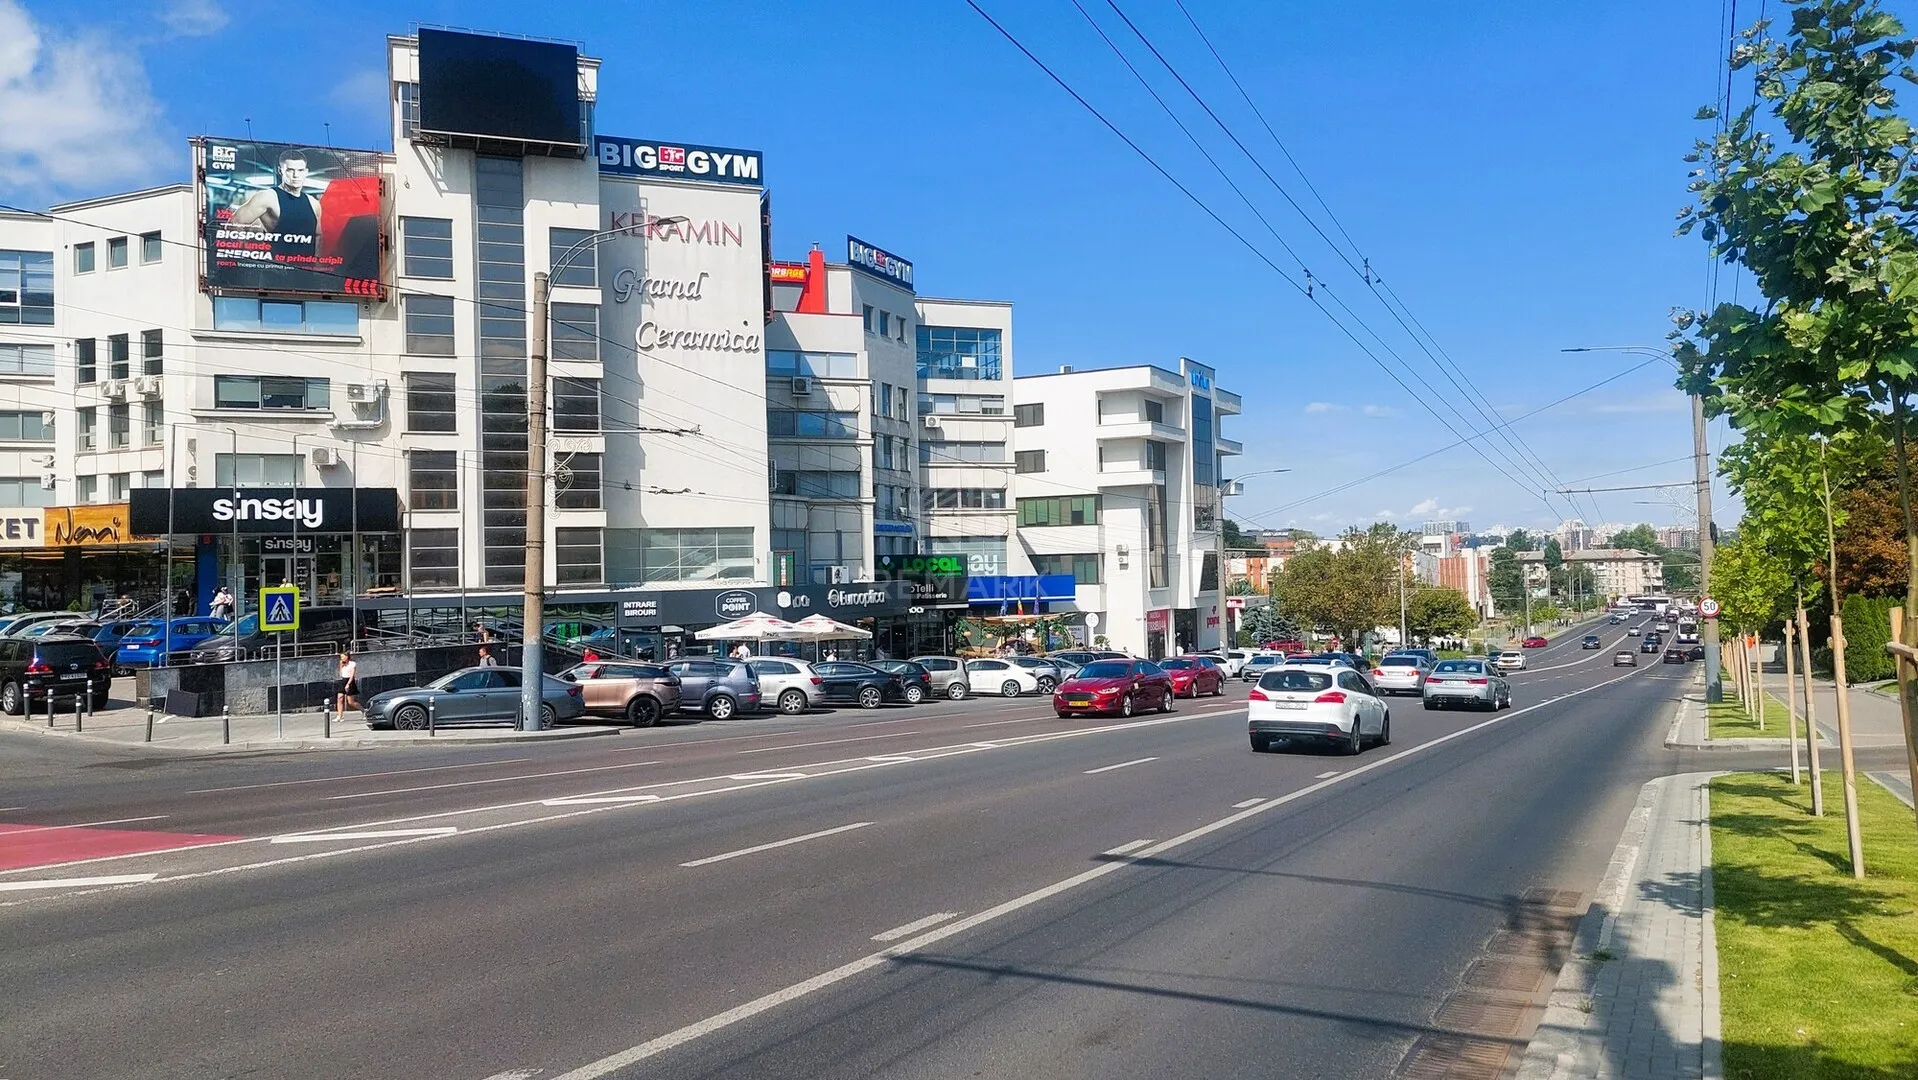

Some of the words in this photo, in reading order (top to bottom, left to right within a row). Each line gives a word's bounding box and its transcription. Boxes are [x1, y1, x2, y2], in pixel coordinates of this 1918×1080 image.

[212, 161, 235, 170] GYM
[600, 142, 657, 169] BIG
[687, 151, 758, 179] GYM
[659, 164, 685, 172] SPORT
[216, 230, 281, 242] BIGSPORT
[284, 234, 312, 244] GYM
[611, 211, 743, 248] KERAMIN
[215, 249, 273, 260] ENERGIA
[850, 240, 875, 268] BIG
[885, 257, 912, 284] GYM
[612, 268, 709, 303] Grand
[635, 320, 760, 353] Ceramica
[212, 492, 323, 528] sinsay
[265, 537, 312, 552] sinsay
[967, 554, 998, 576] ay
[722, 603, 750, 611] POINT
[1703, 602, 1716, 611] 50
